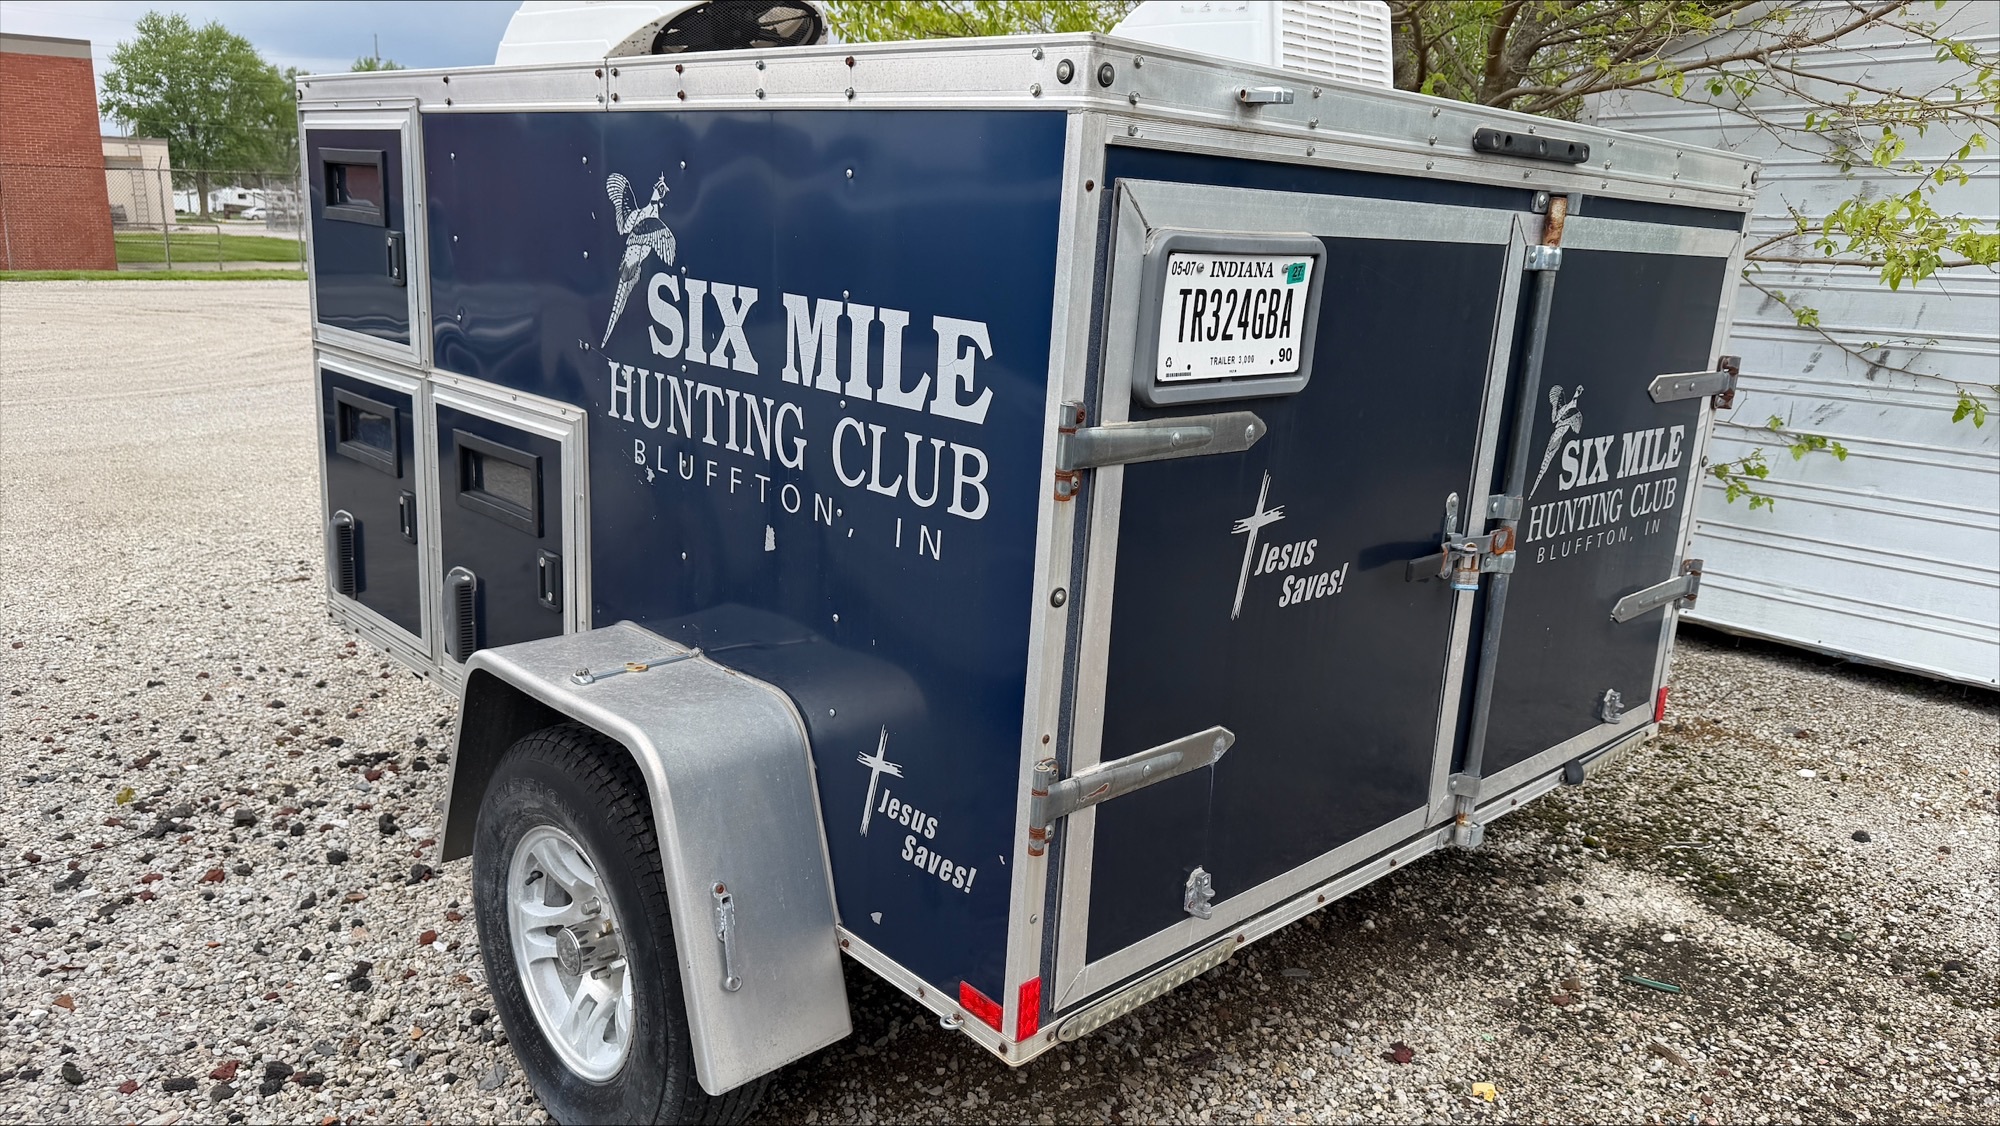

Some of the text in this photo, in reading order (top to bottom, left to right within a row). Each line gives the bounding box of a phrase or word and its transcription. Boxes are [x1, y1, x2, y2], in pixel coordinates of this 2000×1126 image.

[1171, 261, 1196, 276] 05-07
[1209, 261, 1274, 278] INDIANA
[1291, 265, 1303, 278] 27
[1178, 288, 1294, 343] TR324GBA
[647, 272, 994, 425] SIX MILE
[1210, 355, 1235, 366] TRAILER
[1278, 347, 1293, 362] 90
[607, 360, 990, 521] HUNTING CLUB
[1558, 425, 1685, 491] SIX MILE
[633, 438, 942, 561] BLUFFTON, IN
[1525, 477, 1678, 543] HUNTING CLUB
[1254, 538, 1318, 576] Jesus
[1536, 518, 1661, 564] BLUFFTON, IN
[1278, 562, 1350, 608] Saves!
[877, 788, 938, 840] Jesus
[901, 834, 977, 894] Saves!
